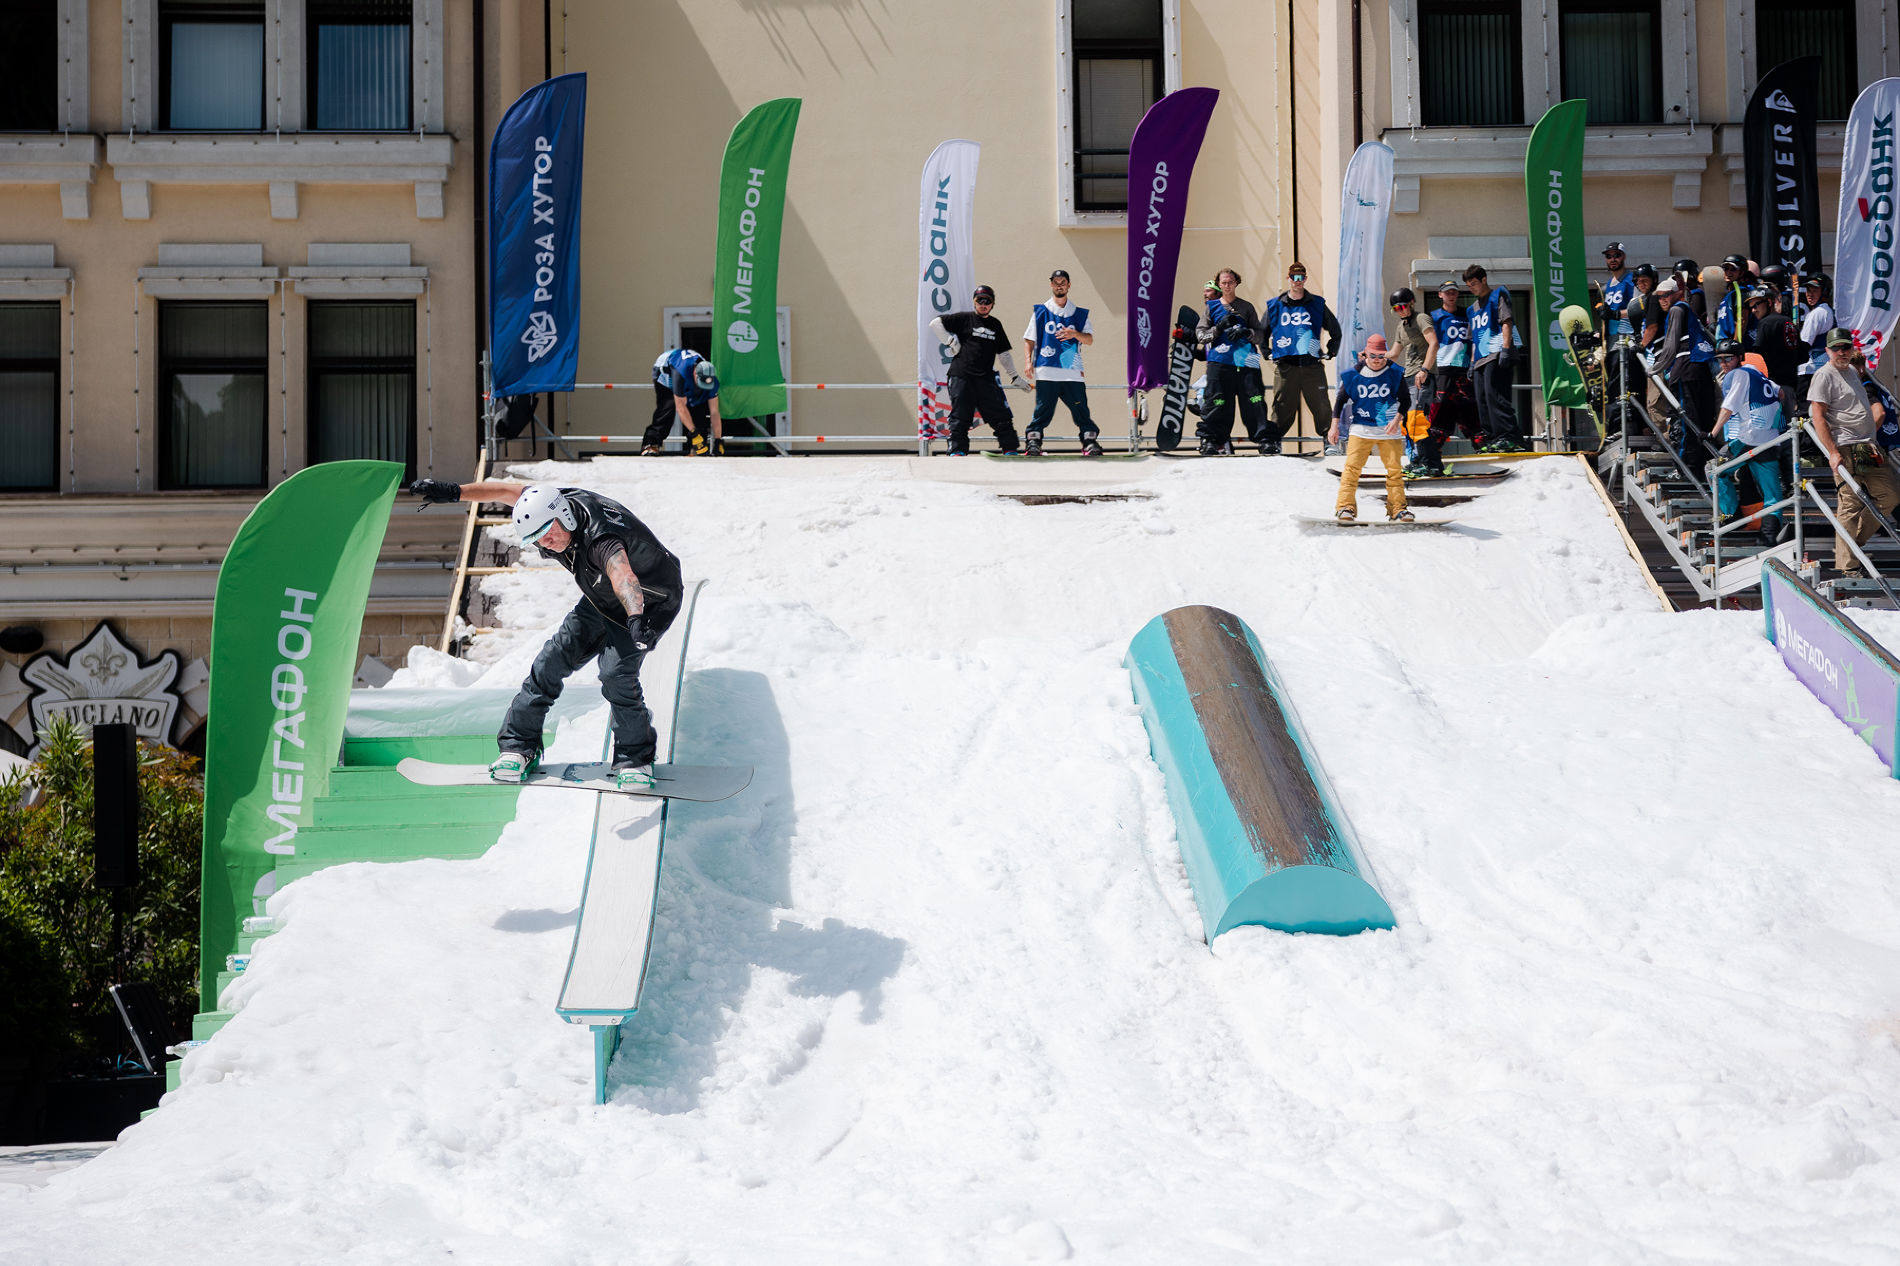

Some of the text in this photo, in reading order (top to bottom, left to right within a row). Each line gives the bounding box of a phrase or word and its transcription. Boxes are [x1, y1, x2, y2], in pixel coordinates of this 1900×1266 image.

[533, 136, 554, 302] РОЗА ХУТОР
[733, 168, 765, 314] МЕГАФОН
[1138, 161, 1169, 301] РОЗА ХУТОР
[1547, 170, 1566, 313] МЕГАФОН
[1281, 311, 1313, 326] 032
[1161, 343, 1194, 434] ANATIC
[1357, 383, 1391, 399] 026
[1787, 623, 1839, 689] МЕГАФОН
[47, 704, 160, 729] UCIANO
[263, 587, 318, 856] МЕГАФОН
